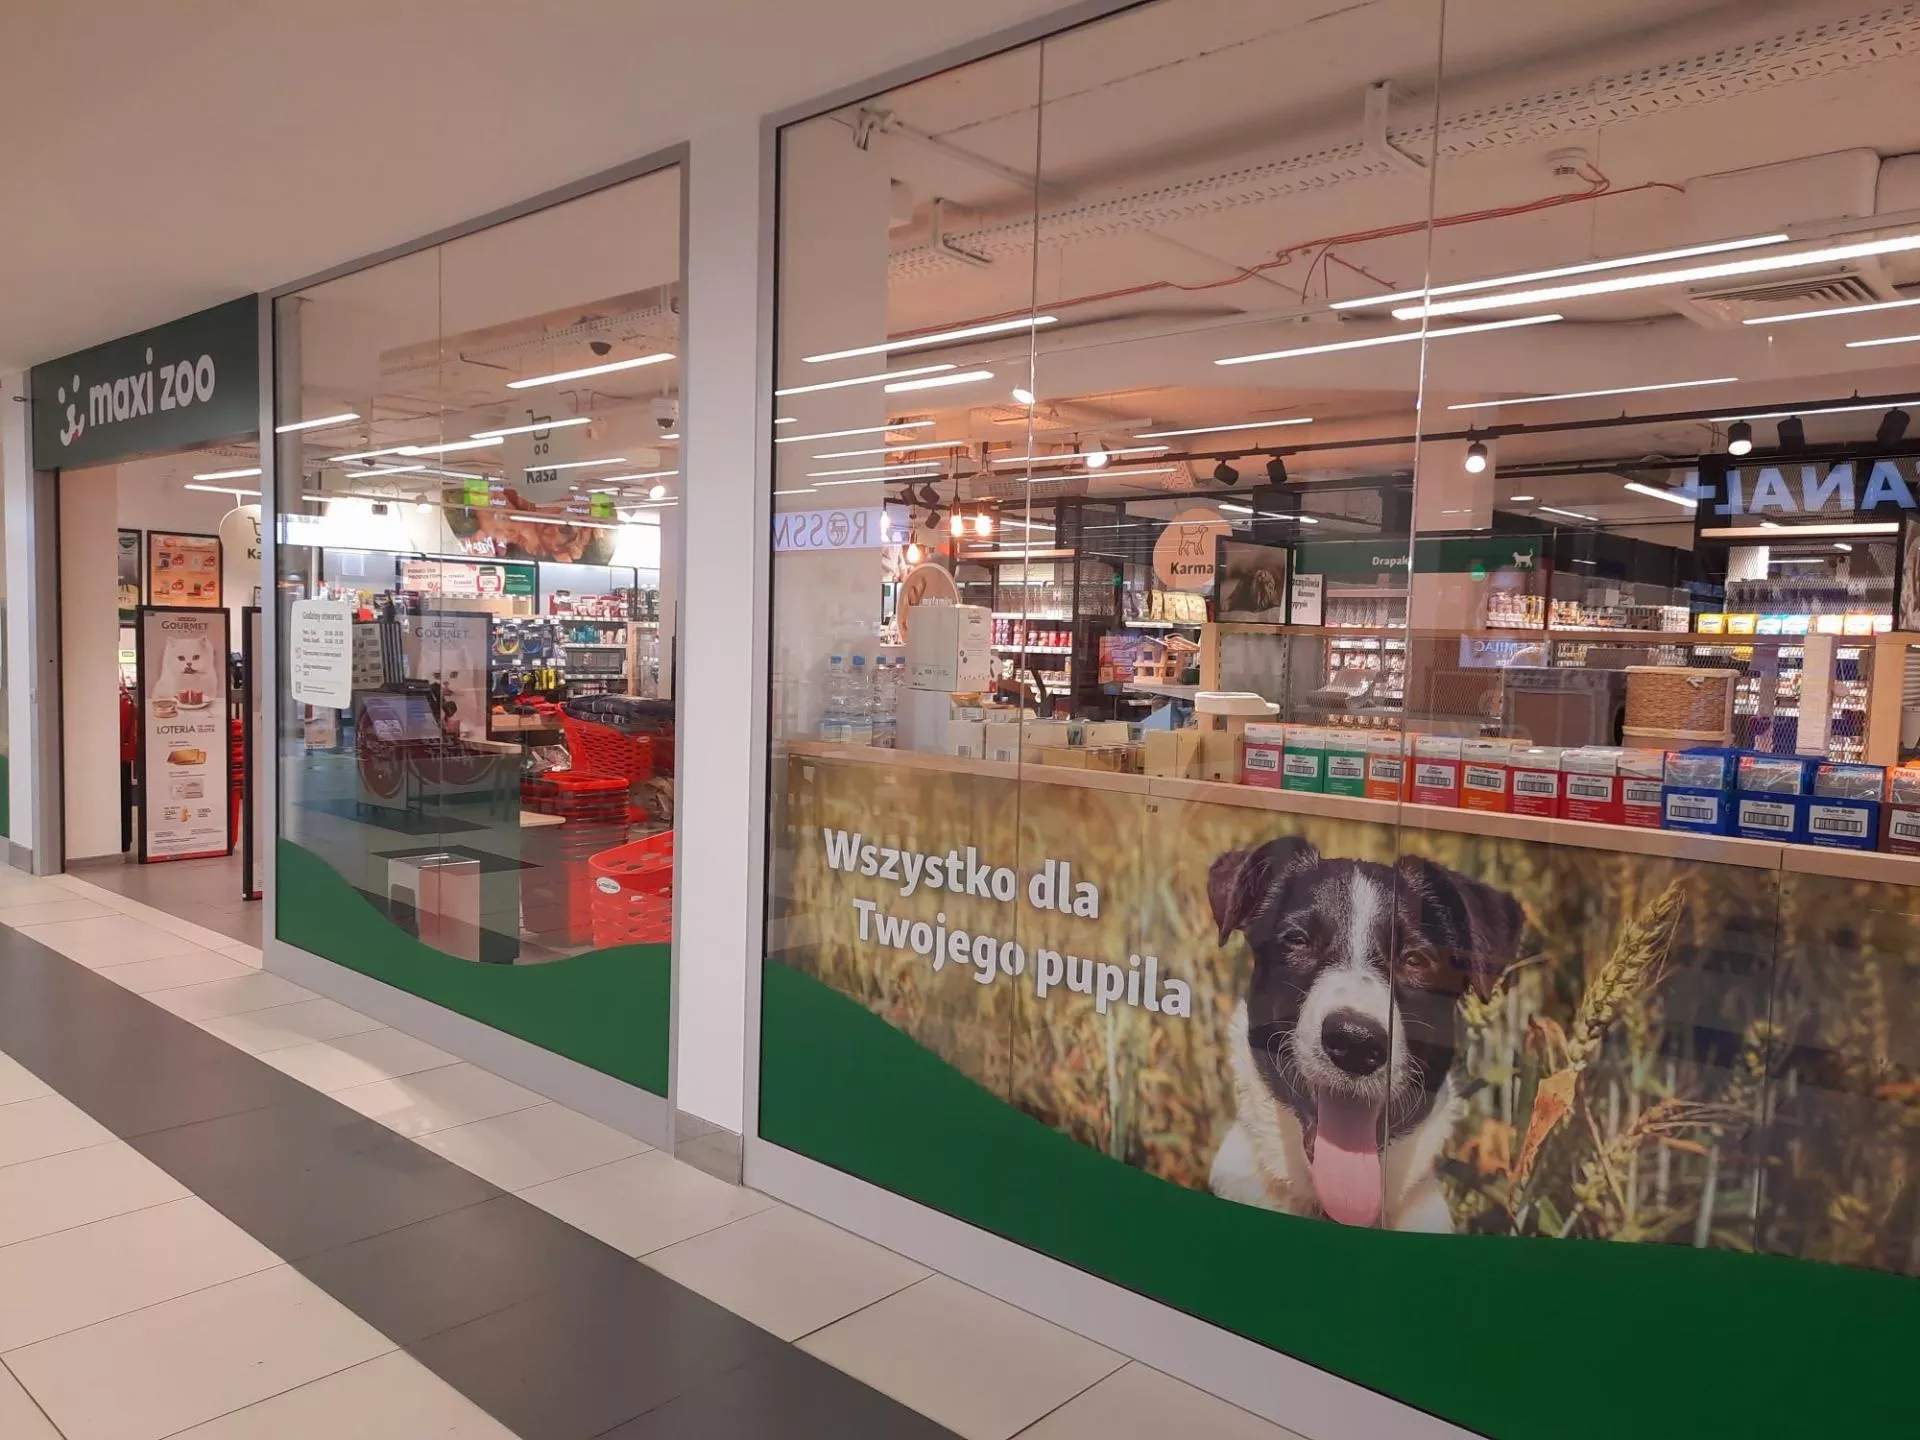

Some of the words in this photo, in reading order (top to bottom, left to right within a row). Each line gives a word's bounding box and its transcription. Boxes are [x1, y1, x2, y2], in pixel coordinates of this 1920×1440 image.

[89, 347, 154, 427] maxi
[160, 354, 216, 411] zoo
[526, 466, 558, 484] Kasa
[1170, 561, 1214, 575] Karma
[1372, 555, 1413, 568] Drapak
[161, 620, 209, 631] GOURMET
[156, 724, 196, 735] LOTERIA
[823, 827, 1017, 902] Wszystko
[1028, 858, 1100, 919] dla
[852, 898, 1025, 985] Twojego
[1036, 948, 1192, 1018] pupila
